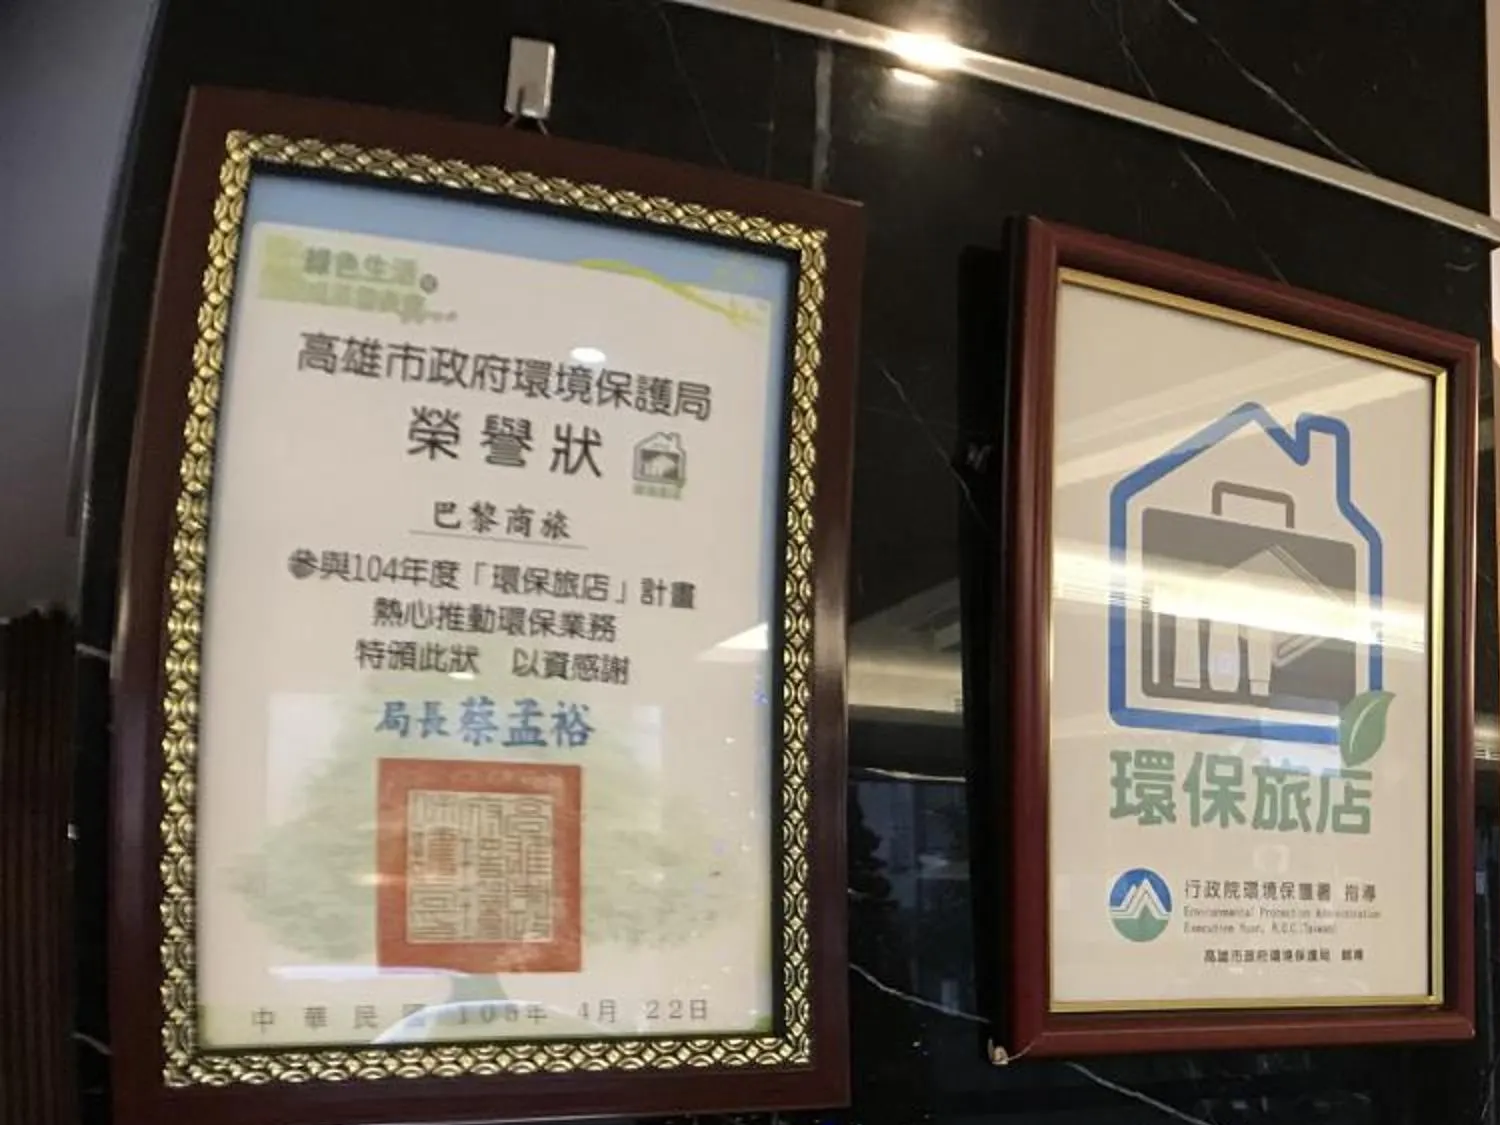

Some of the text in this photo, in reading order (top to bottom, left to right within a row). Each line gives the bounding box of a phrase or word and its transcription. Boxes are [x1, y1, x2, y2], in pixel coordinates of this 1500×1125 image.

[298, 331, 713, 422] 高雄市政府環境保護局
[406, 405, 604, 479] 榮譽狀
[433, 500, 572, 540] 巴黎商旅
[372, 596, 617, 644] 熱心推動環保業務
[511, 647, 630, 685] 以資感謝
[1109, 749, 1374, 835] 環保旅店
